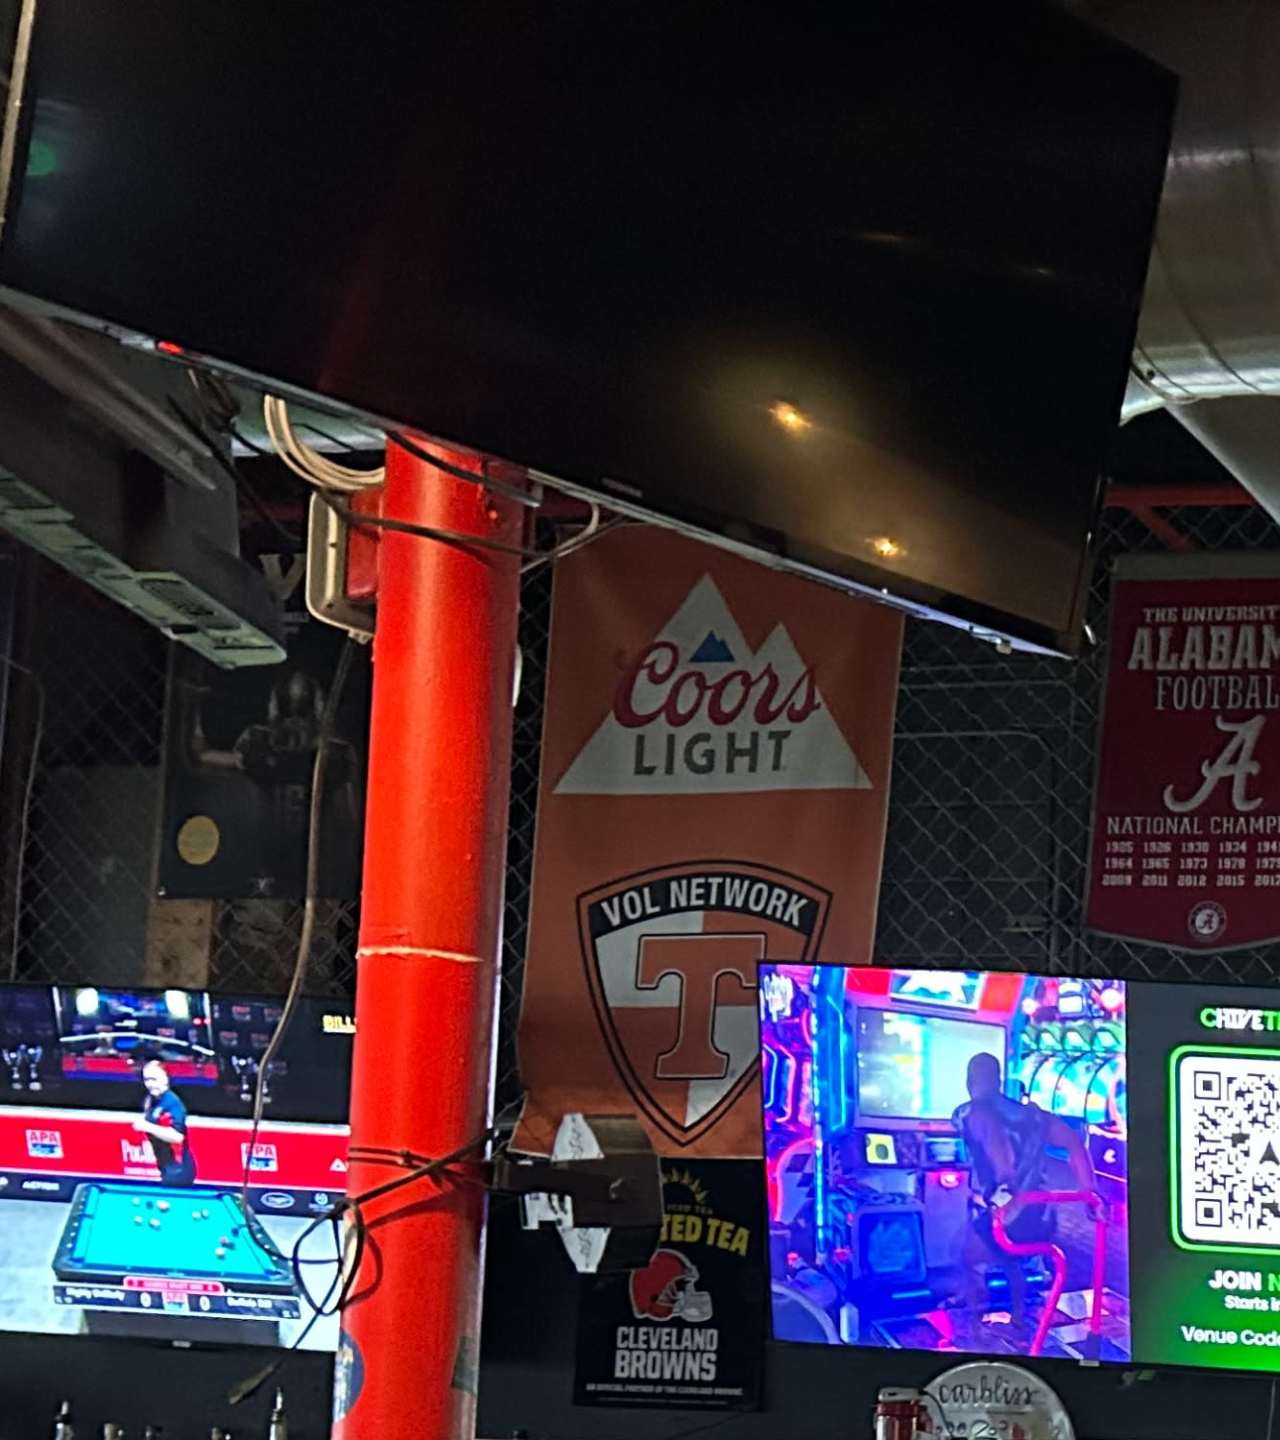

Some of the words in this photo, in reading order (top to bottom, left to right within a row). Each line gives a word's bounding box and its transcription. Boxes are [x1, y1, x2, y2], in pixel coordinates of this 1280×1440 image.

[1143, 608, 1177, 622] THE
[613, 640, 822, 729] Coors
[634, 730, 791, 775] LIGHT
[1107, 816, 1203, 835] NATIONAL
[602, 896, 661, 927] VOL
[669, 876, 810, 926] NETWORK
[322, 1015, 357, 1033] BILL
[707, 1215, 750, 1256] TEA
[1208, 1269, 1262, 1291] JOIN
[616, 1326, 719, 1351] CLEVELAND
[1181, 1326, 1238, 1346] Venue
[614, 1350, 716, 1380] BROWNS
[939, 1375, 1040, 1406] carbliss
